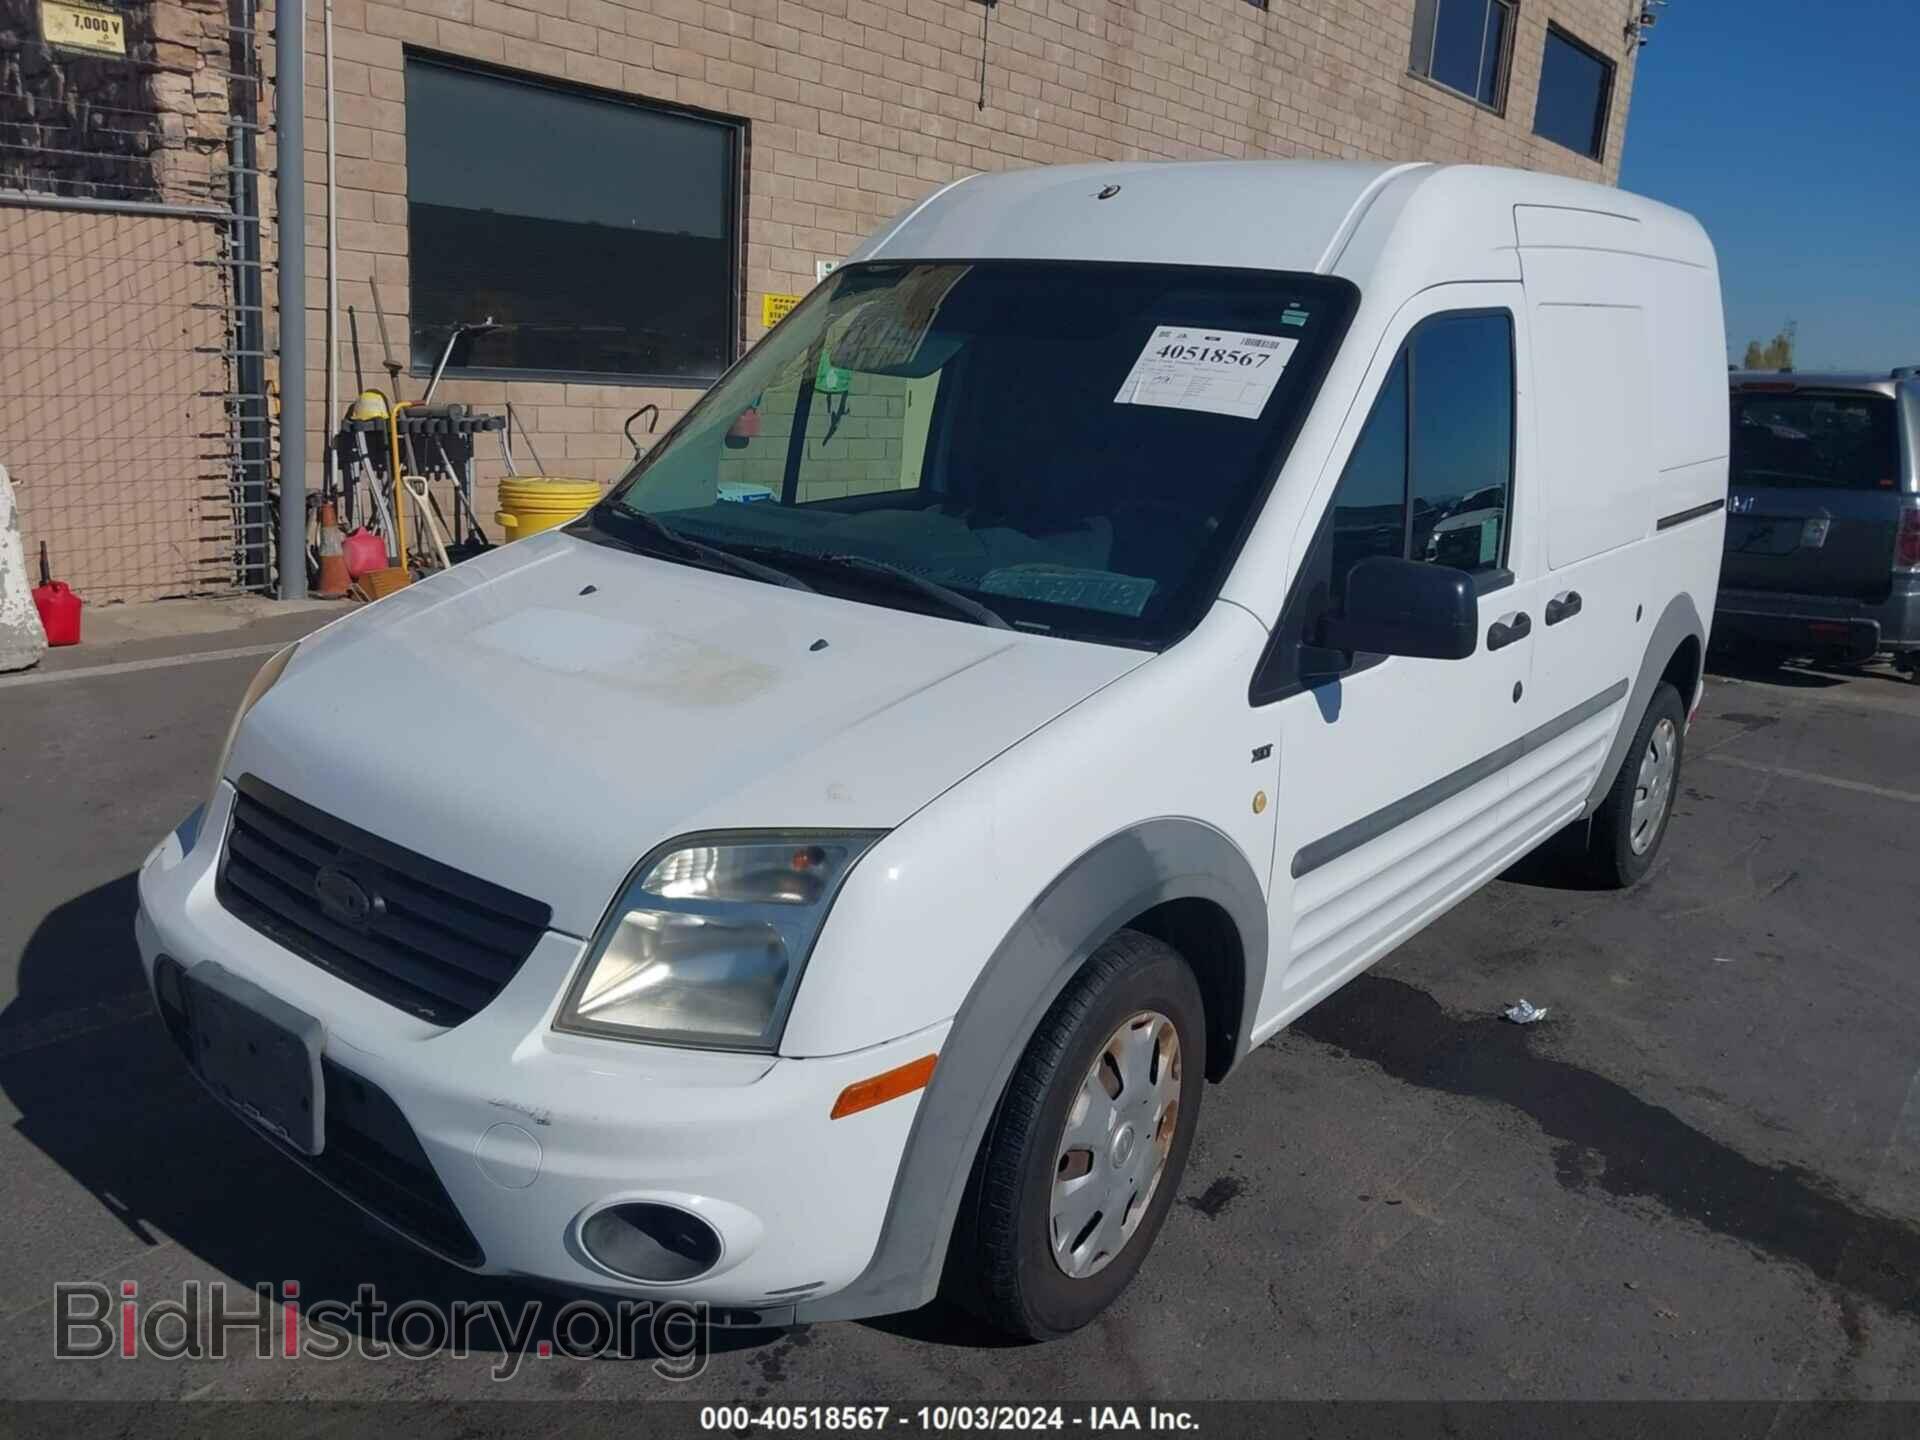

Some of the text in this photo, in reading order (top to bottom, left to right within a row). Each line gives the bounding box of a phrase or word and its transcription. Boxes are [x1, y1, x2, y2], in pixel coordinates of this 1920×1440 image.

[73, 14, 120, 35] 7,000 V
[1156, 343, 1271, 369] 40518567
